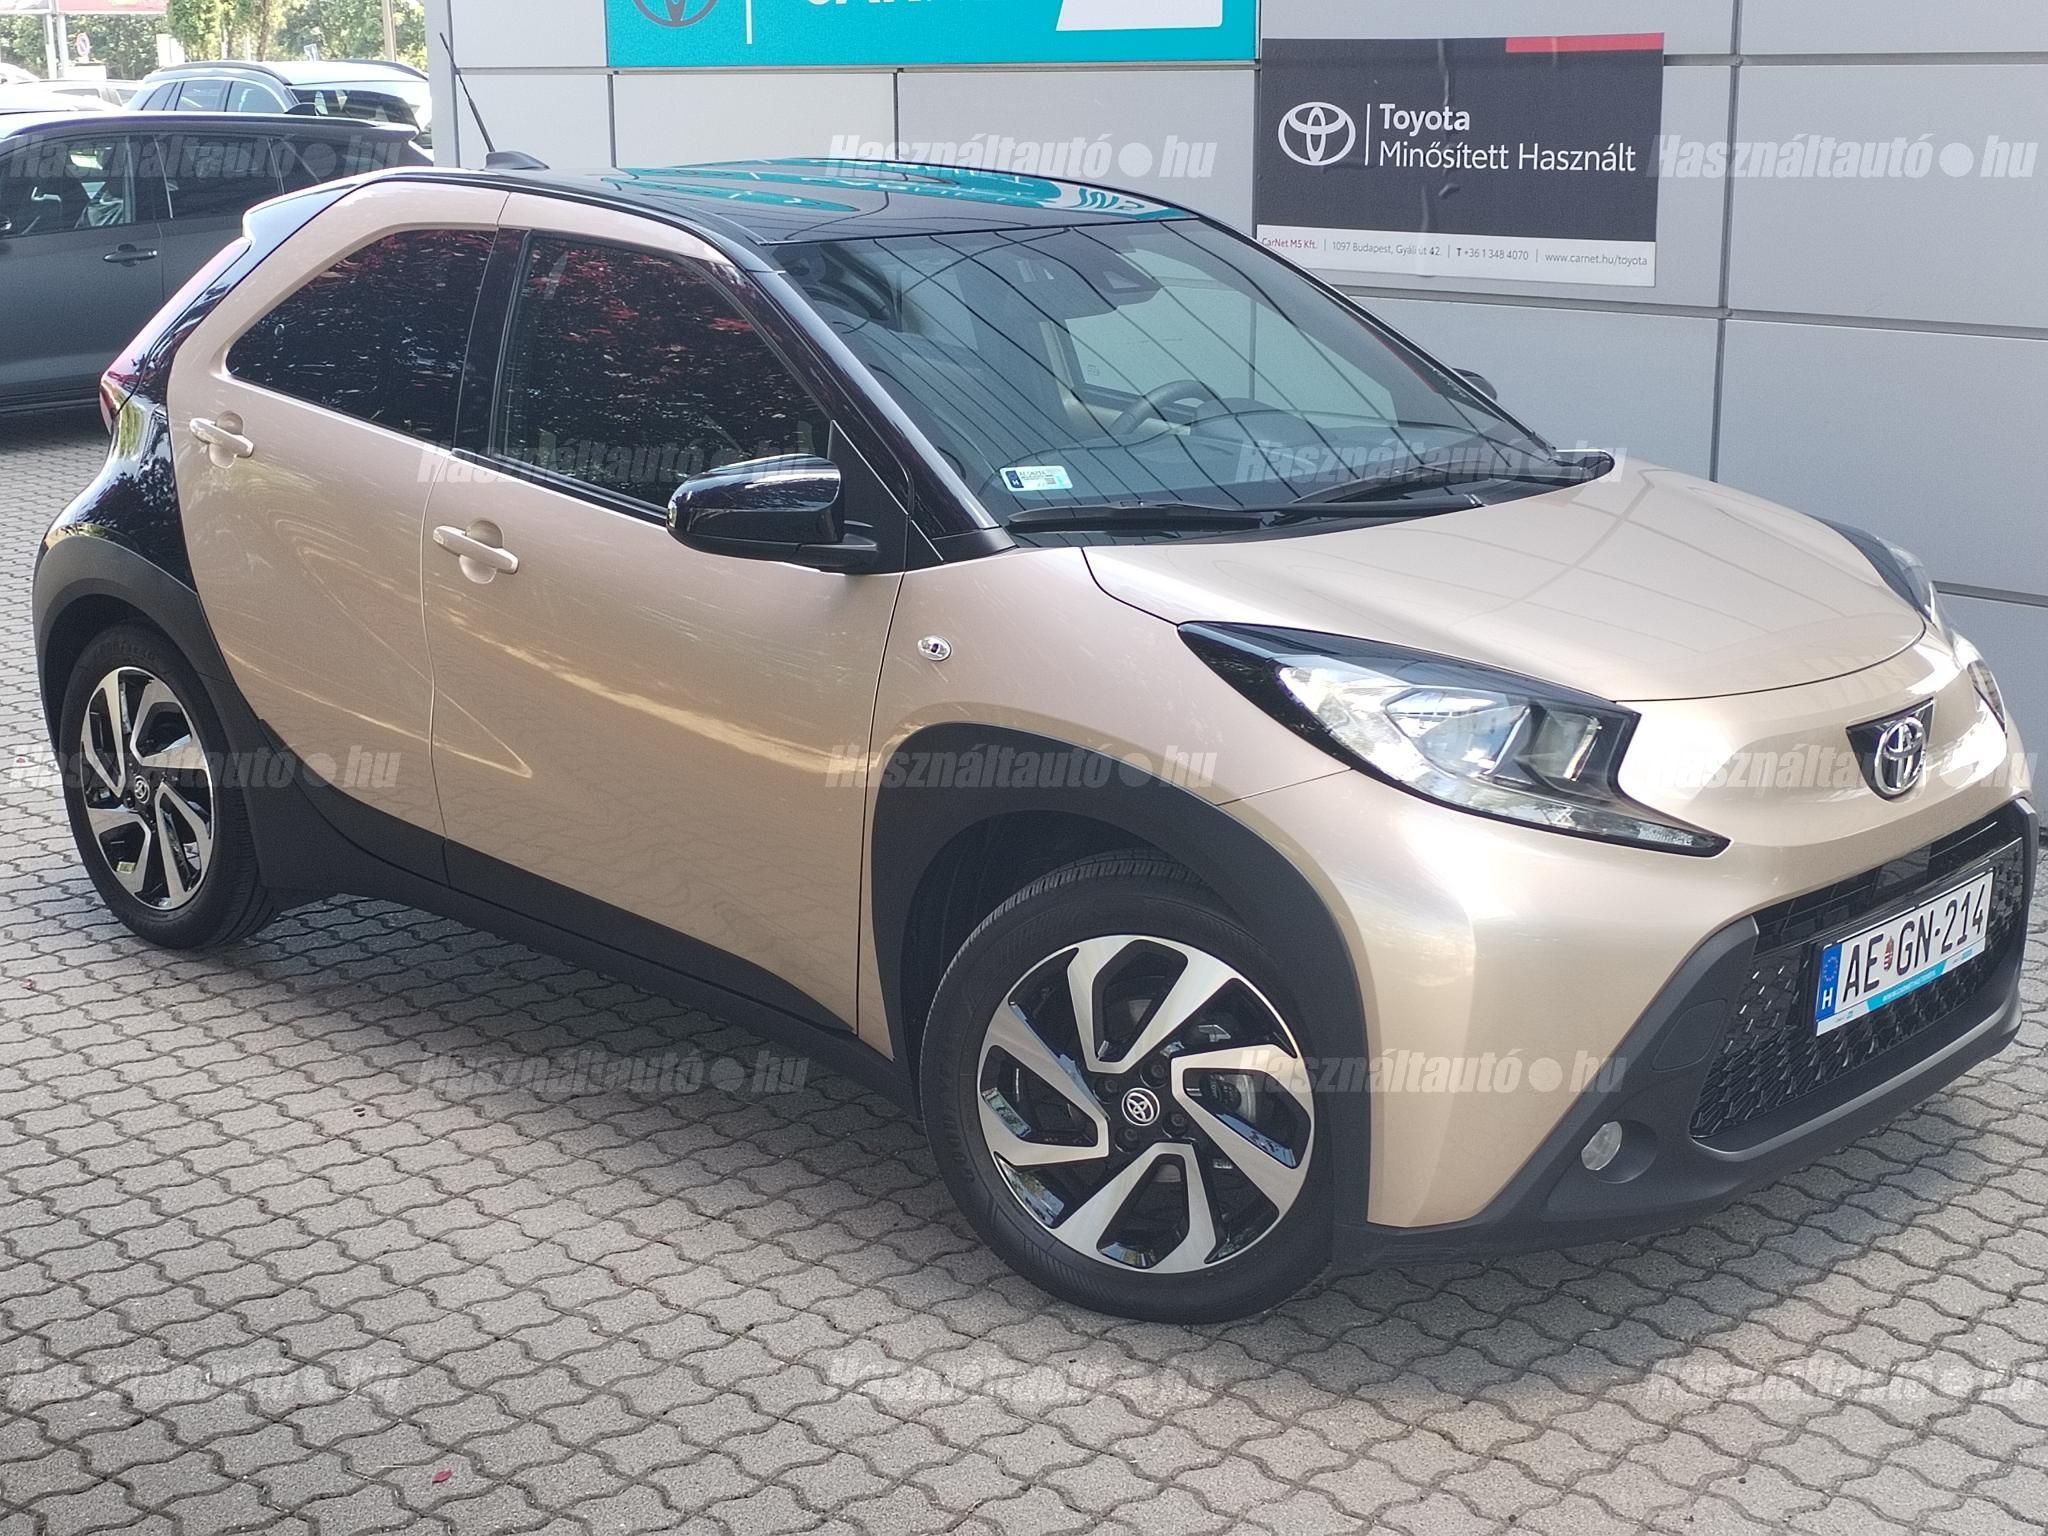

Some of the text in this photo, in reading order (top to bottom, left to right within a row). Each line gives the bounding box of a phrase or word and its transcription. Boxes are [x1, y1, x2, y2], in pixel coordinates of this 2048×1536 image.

[1379, 103, 1471, 137] Toyota
[1379, 140, 1636, 172] Minősített Használt
[1262, 237, 1289, 248] CarNet
[1332, 241, 1351, 252] 1097
[1352, 243, 1393, 255] Budapest,
[1429, 246, 1441, 257] 42
[1488, 248, 1505, 259] 348
[1506, 249, 1529, 261] 4070
[1545, 252, 1648, 268] www.carnet.hu/toyota
[1842, 932, 1885, 1003] AE
[1821, 986, 1835, 1011] H
